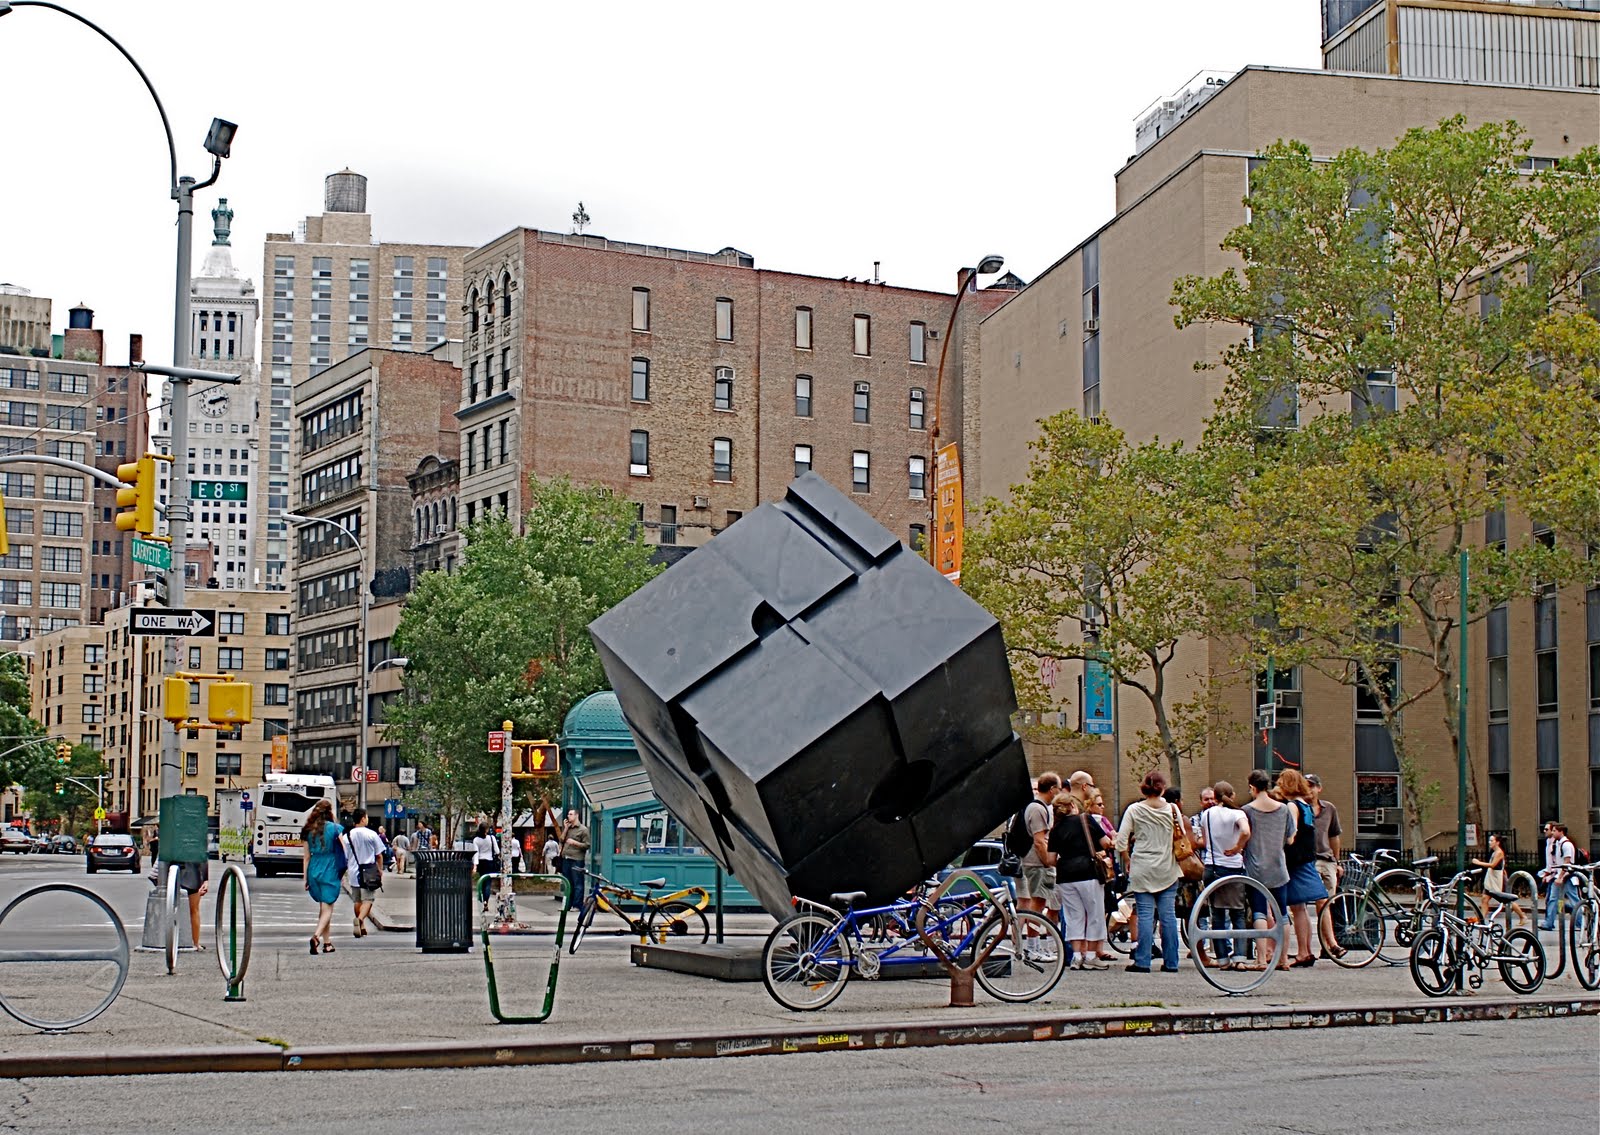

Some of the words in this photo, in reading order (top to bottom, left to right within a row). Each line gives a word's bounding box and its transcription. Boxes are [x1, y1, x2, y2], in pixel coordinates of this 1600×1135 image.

[198, 482, 208, 498] E
[213, 482, 224, 499] 8
[229, 483, 239, 492] ST
[132, 541, 161, 565] LAFAYETTE
[141, 616, 167, 628] ONE
[177, 617, 203, 629] WAY
[268, 833, 291, 841] JERSEY
[291, 833, 301, 841] BO
